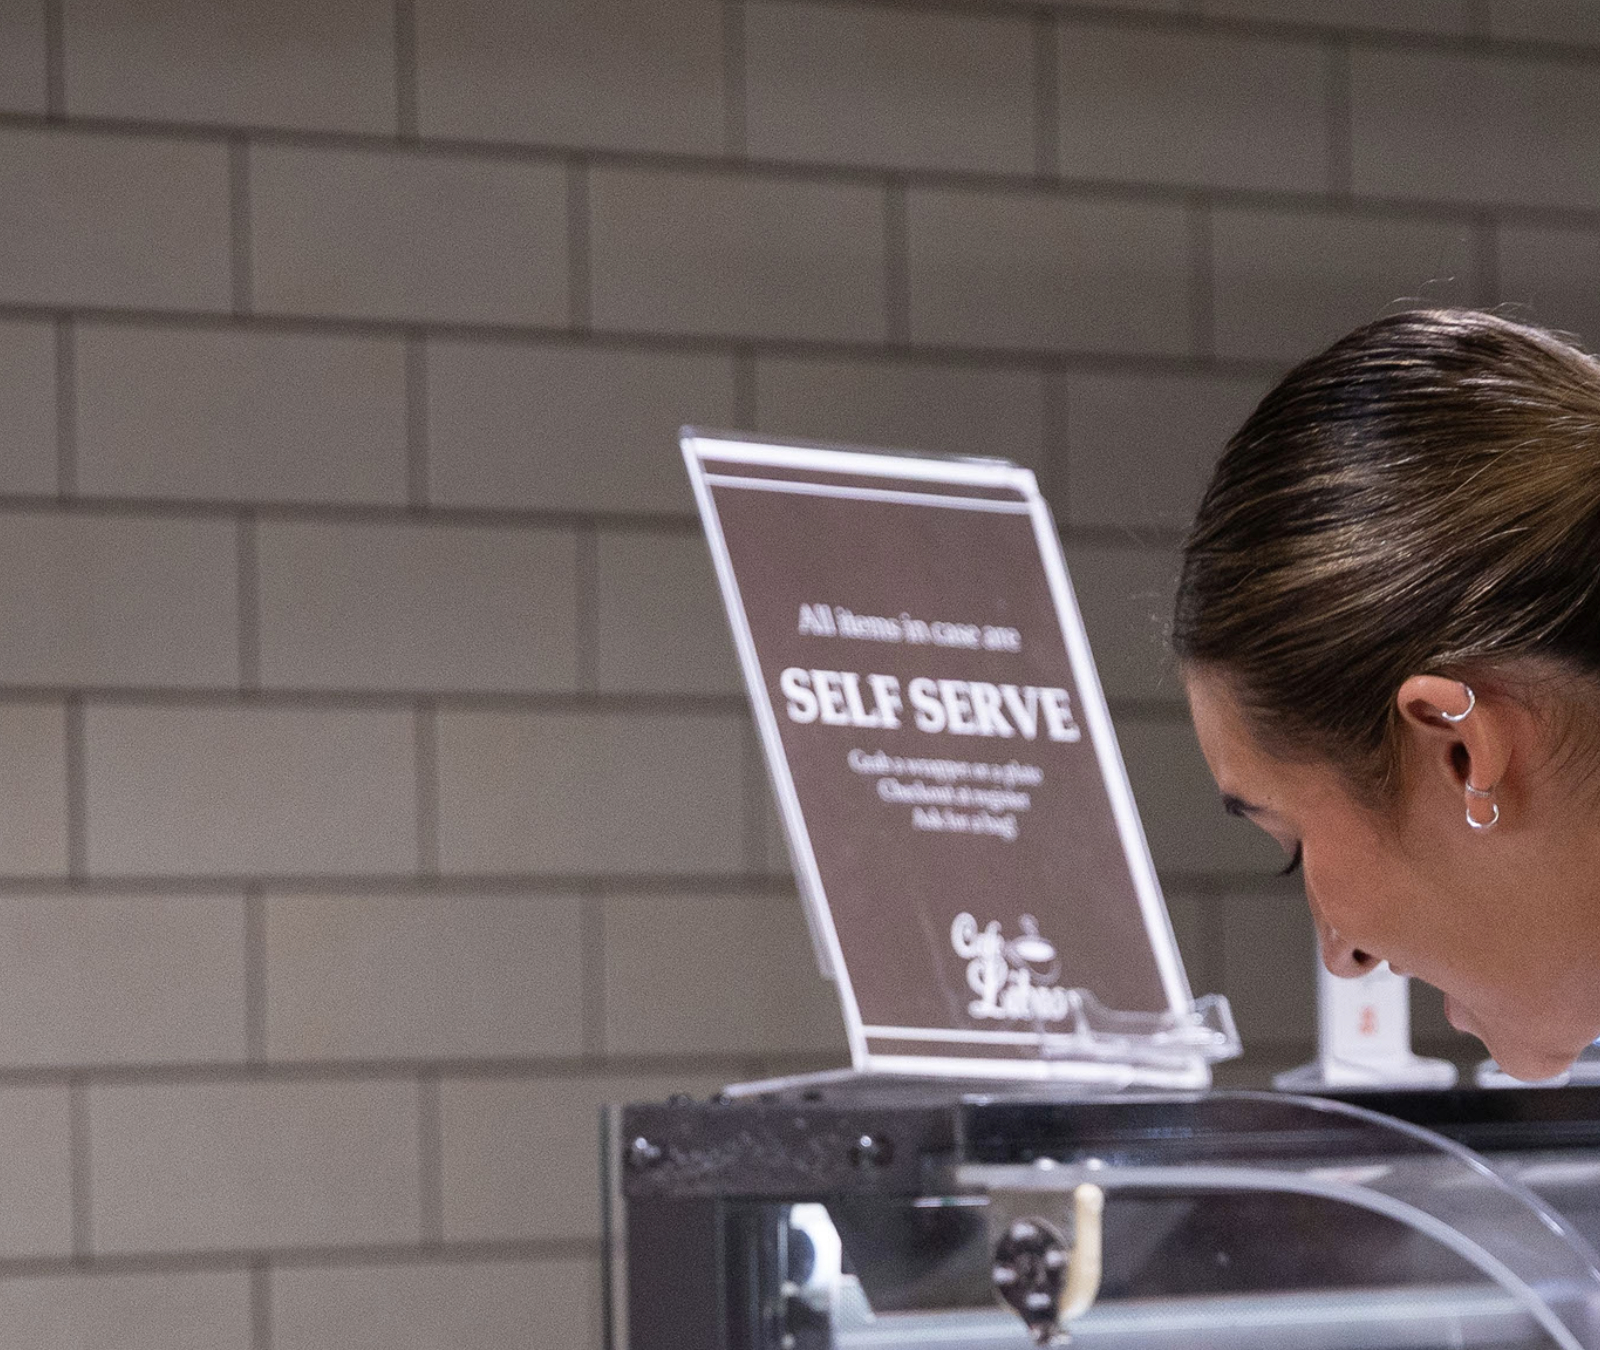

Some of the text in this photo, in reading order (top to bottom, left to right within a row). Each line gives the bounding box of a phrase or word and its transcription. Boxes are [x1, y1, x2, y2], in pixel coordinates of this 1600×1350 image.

[798, 603, 1021, 652] All items in case are
[780, 667, 1081, 743] SELF SERVE
